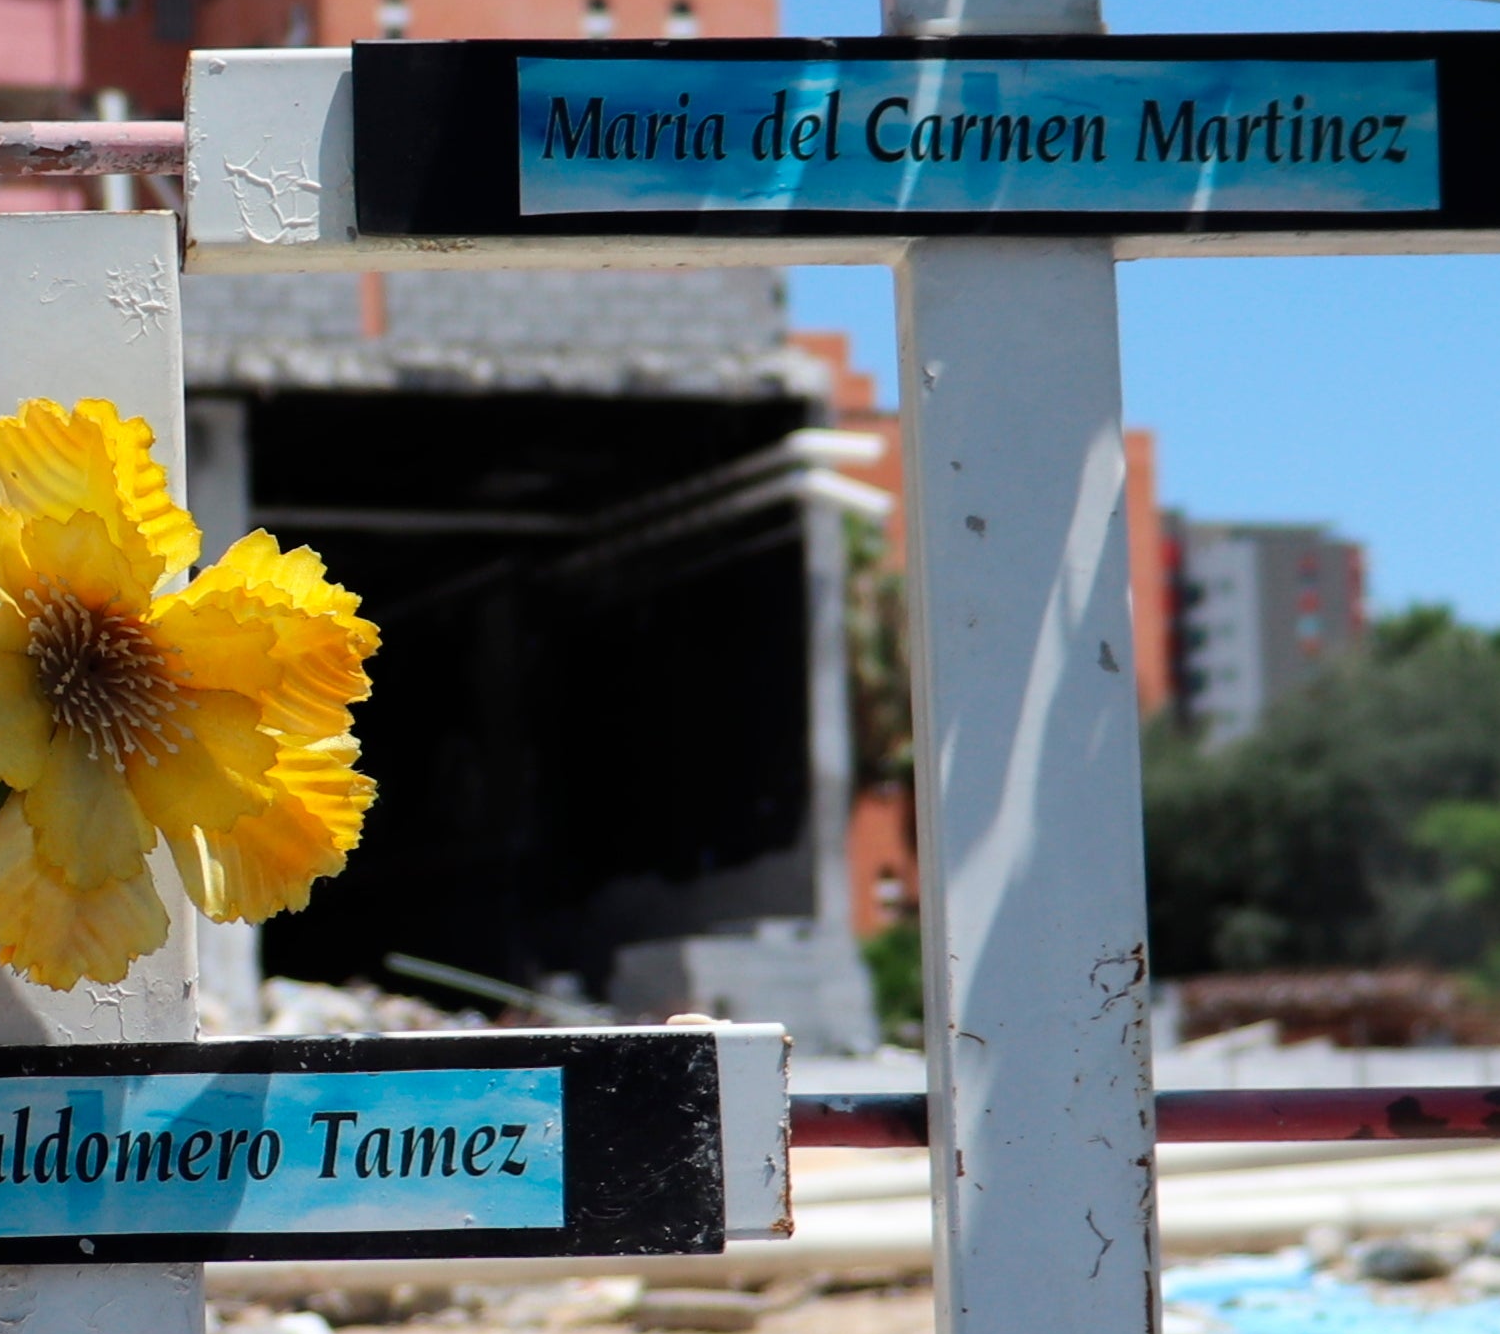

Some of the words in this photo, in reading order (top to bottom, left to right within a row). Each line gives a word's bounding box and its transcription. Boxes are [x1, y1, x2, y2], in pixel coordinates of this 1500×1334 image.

[540, 92, 728, 162] Maria
[750, 91, 840, 162] del
[865, 96, 1106, 164] Carmen
[1134, 93, 1408, 164] Martinez
[310, 1111, 528, 1180] Tamez
